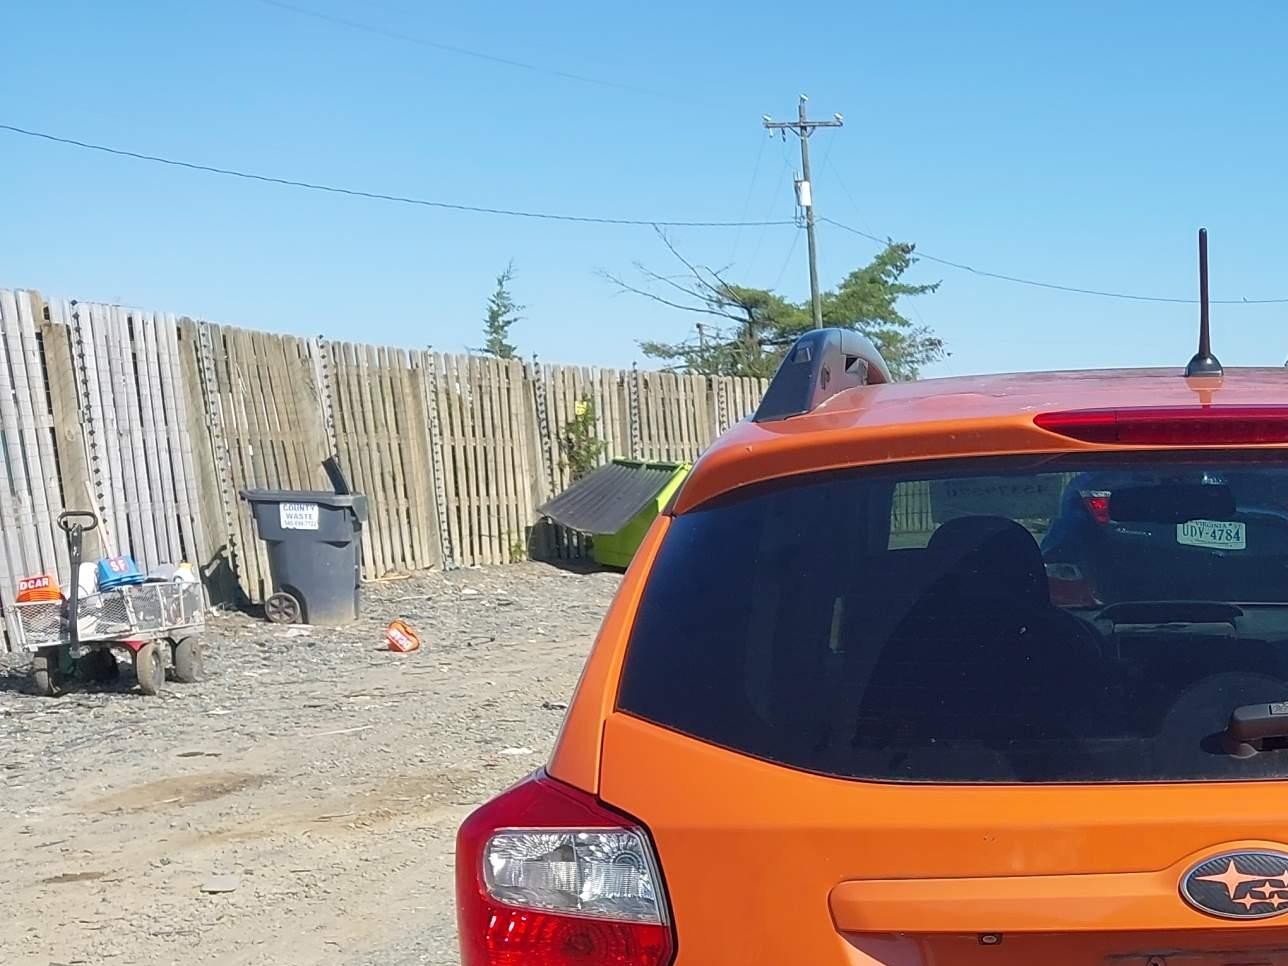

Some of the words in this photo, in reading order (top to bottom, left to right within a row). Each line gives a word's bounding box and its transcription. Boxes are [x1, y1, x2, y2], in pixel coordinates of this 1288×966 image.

[283, 503, 315, 511] COUNTY
[286, 513, 313, 521] WASTE
[17, 577, 49, 591] DCAR
